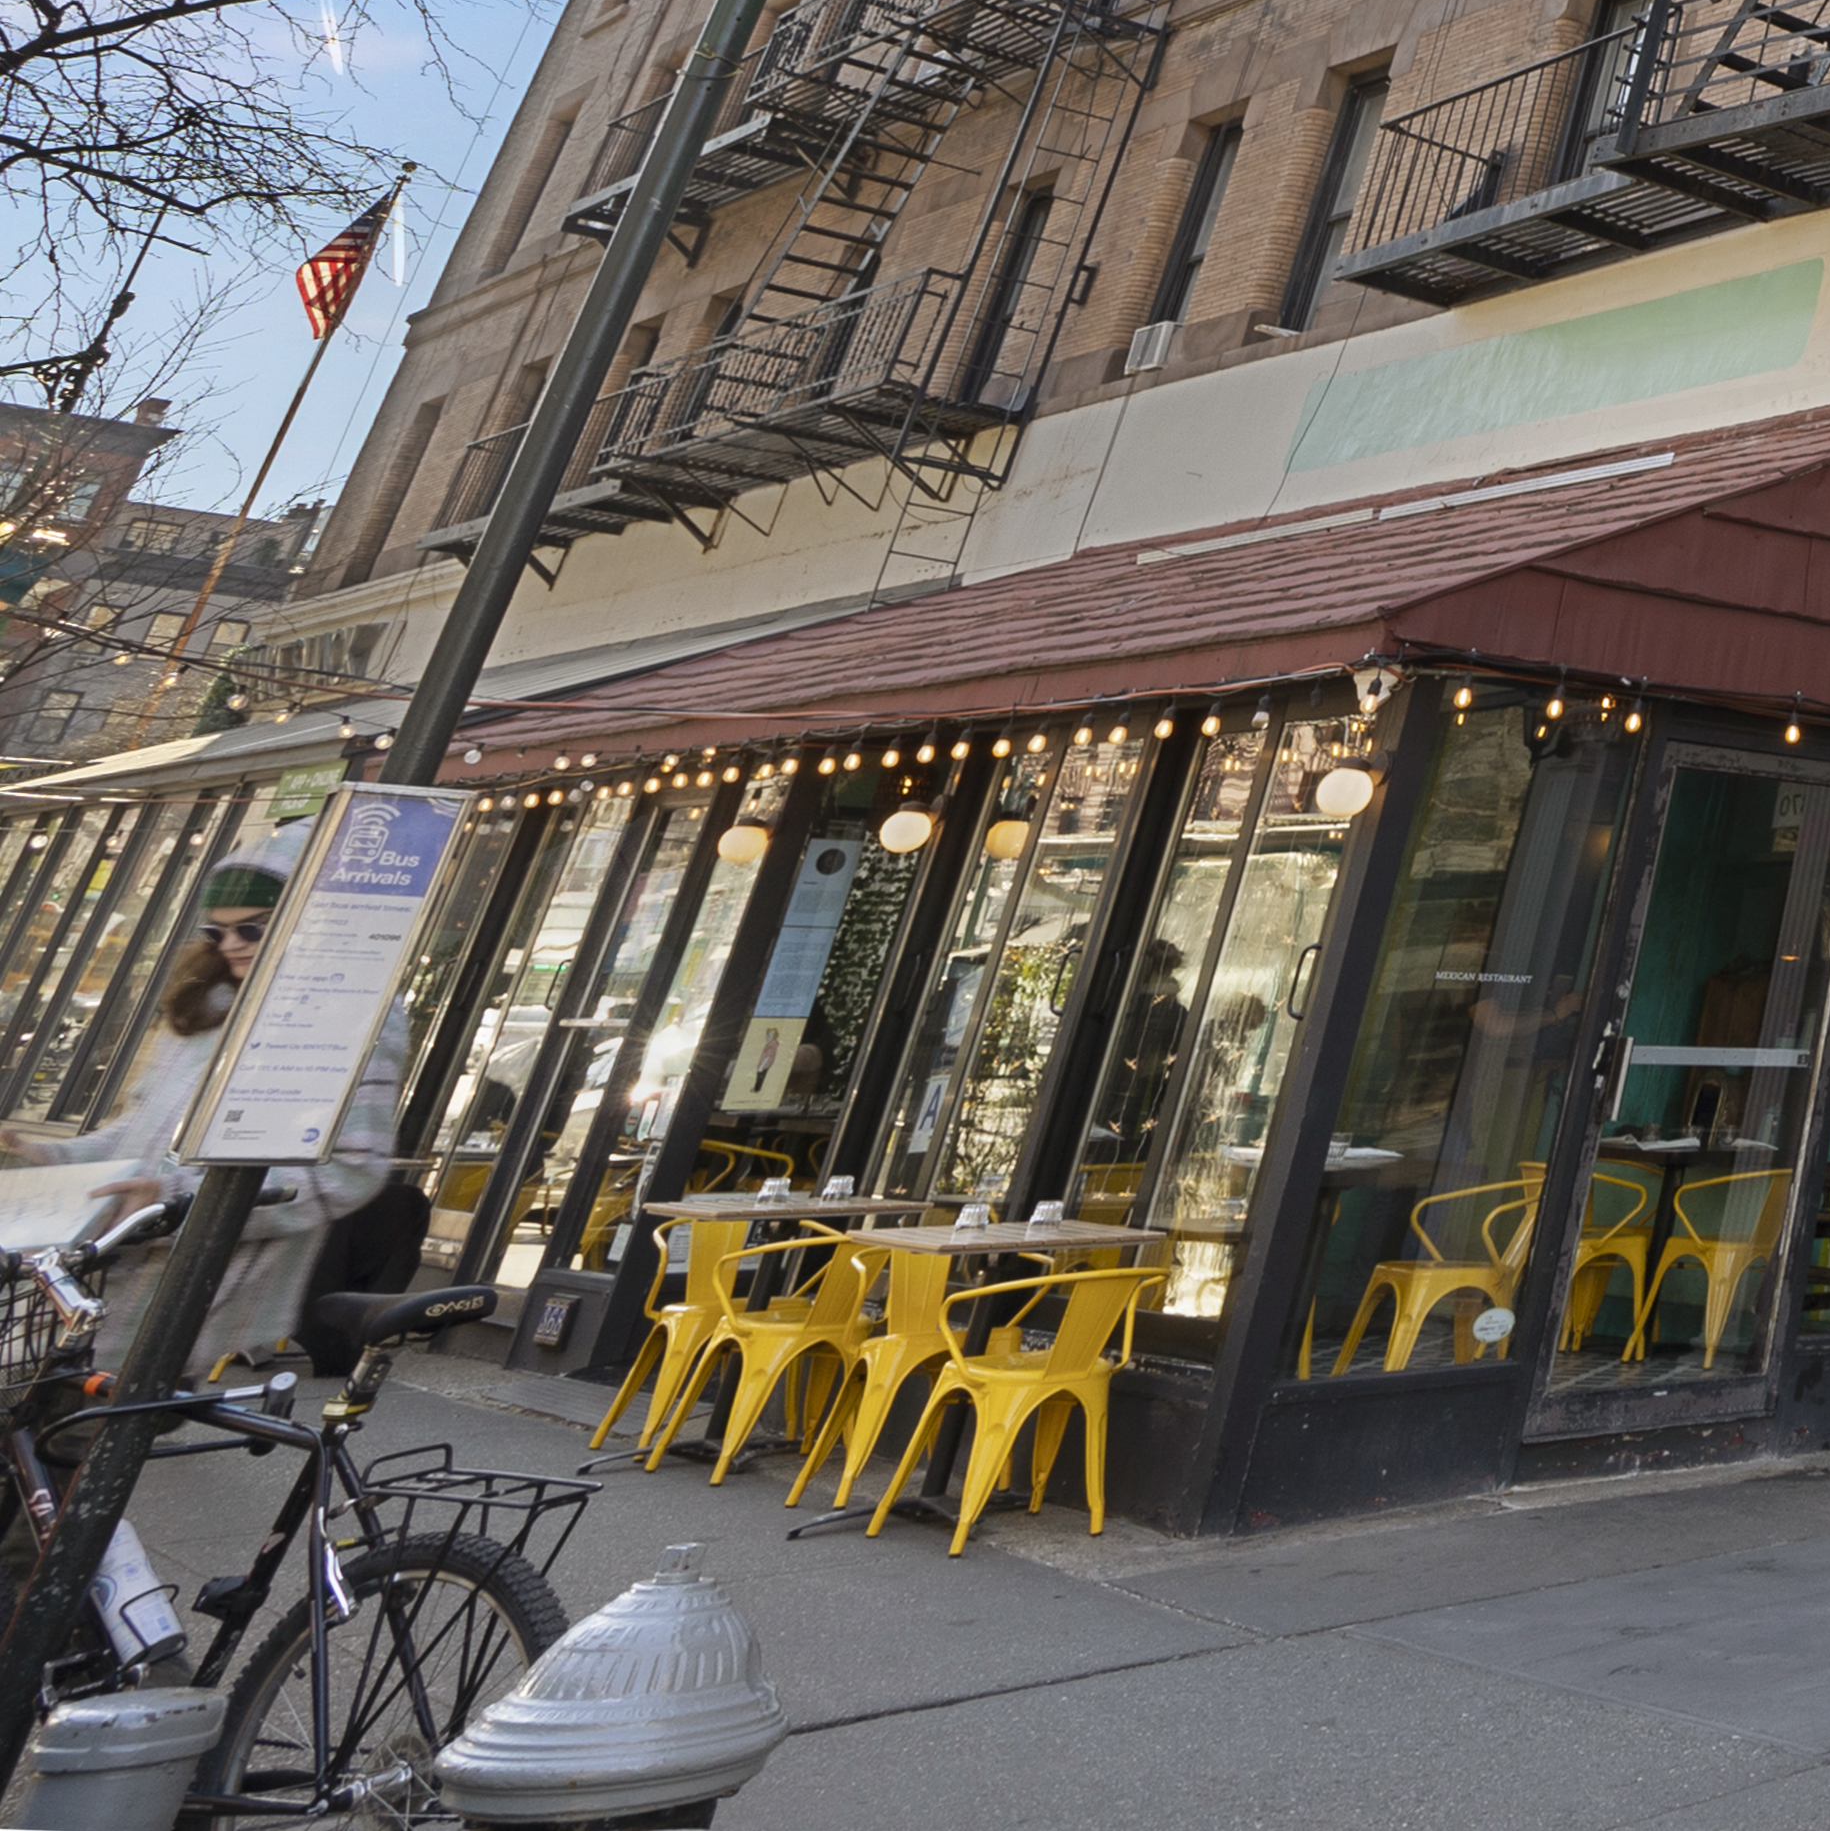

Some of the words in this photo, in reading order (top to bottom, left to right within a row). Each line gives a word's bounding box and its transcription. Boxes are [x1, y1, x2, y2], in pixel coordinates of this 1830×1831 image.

[379, 851, 421, 867] Bus
[329, 868, 413, 886] Arrivals
[1435, 971, 1477, 981] MEXICAN
[1478, 972, 1533, 984] RESTAURANT
[917, 1083, 943, 1131] A
